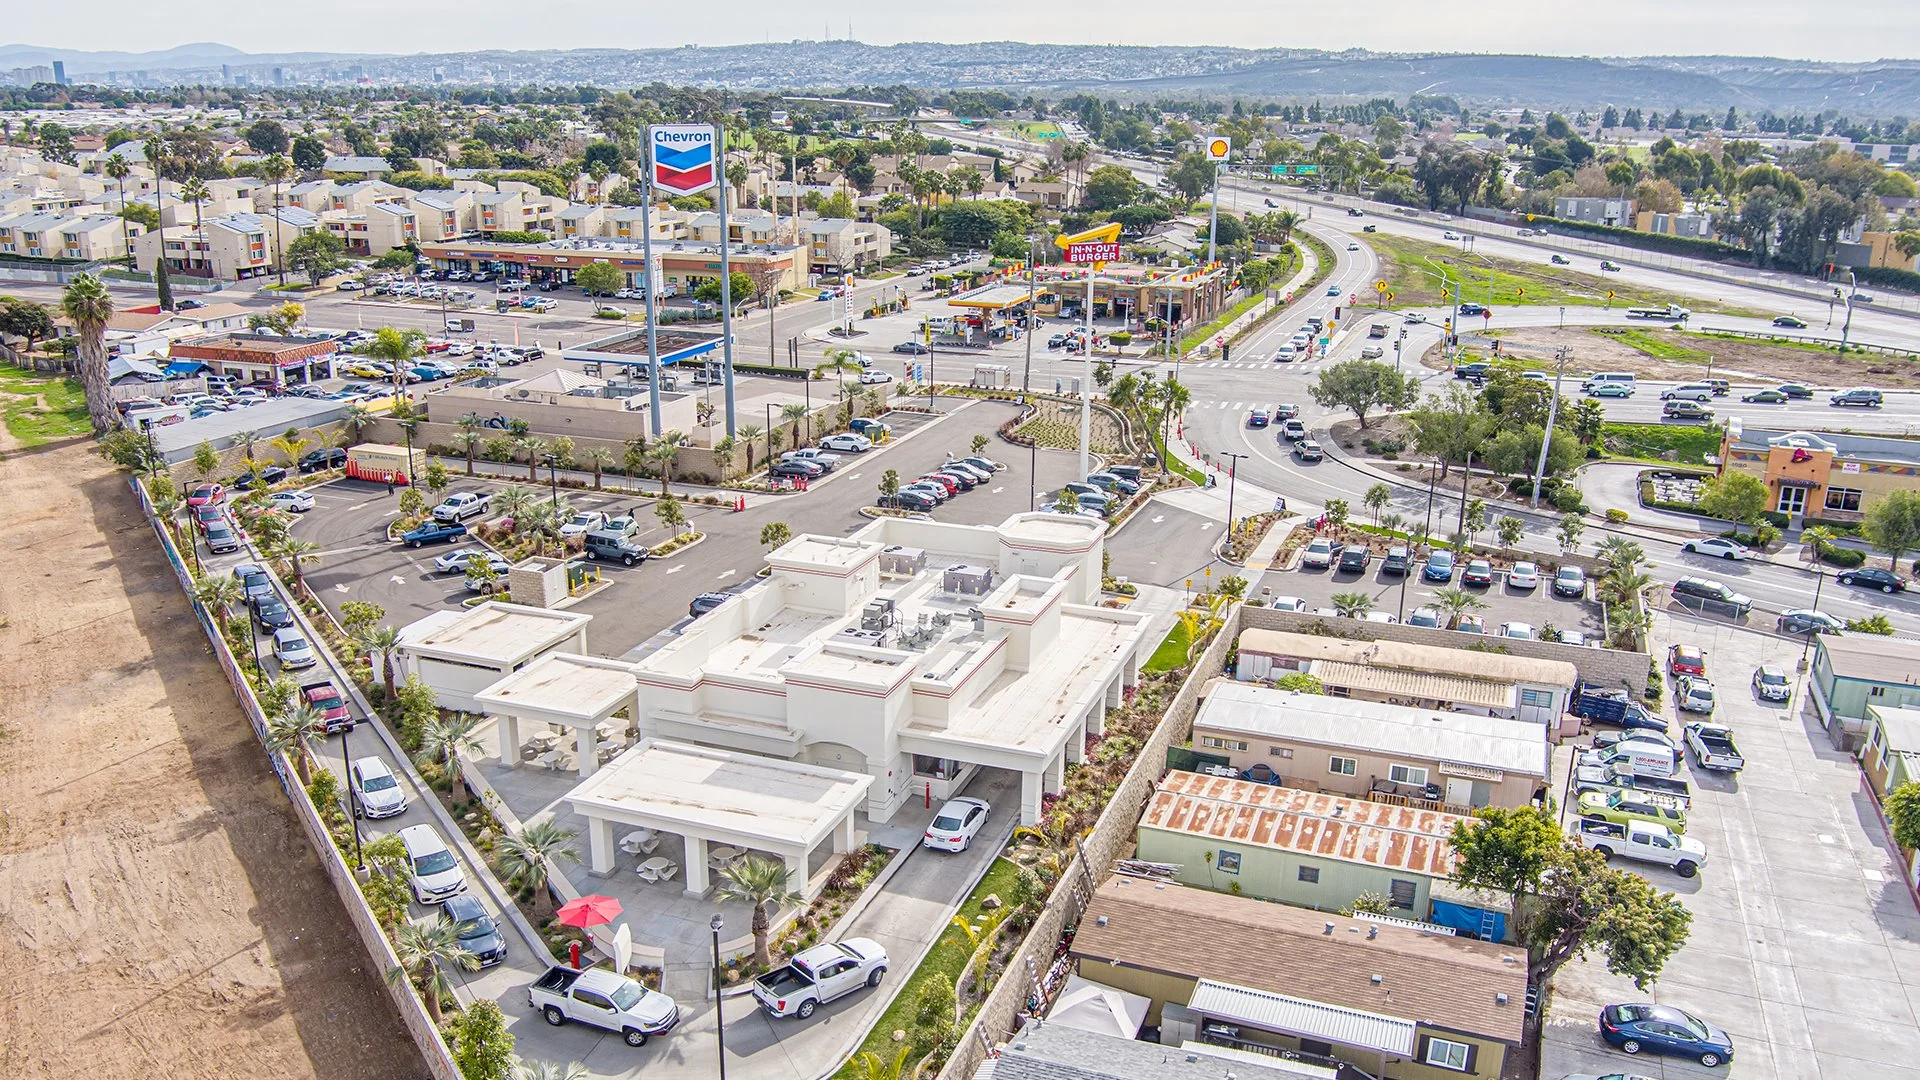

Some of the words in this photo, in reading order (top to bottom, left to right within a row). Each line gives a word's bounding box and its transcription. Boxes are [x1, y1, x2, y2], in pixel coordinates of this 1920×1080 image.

[654, 130, 711, 142] Chevron
[1070, 244, 1117, 254] IN-N-OUT
[1070, 252, 1117, 262] BURGER
